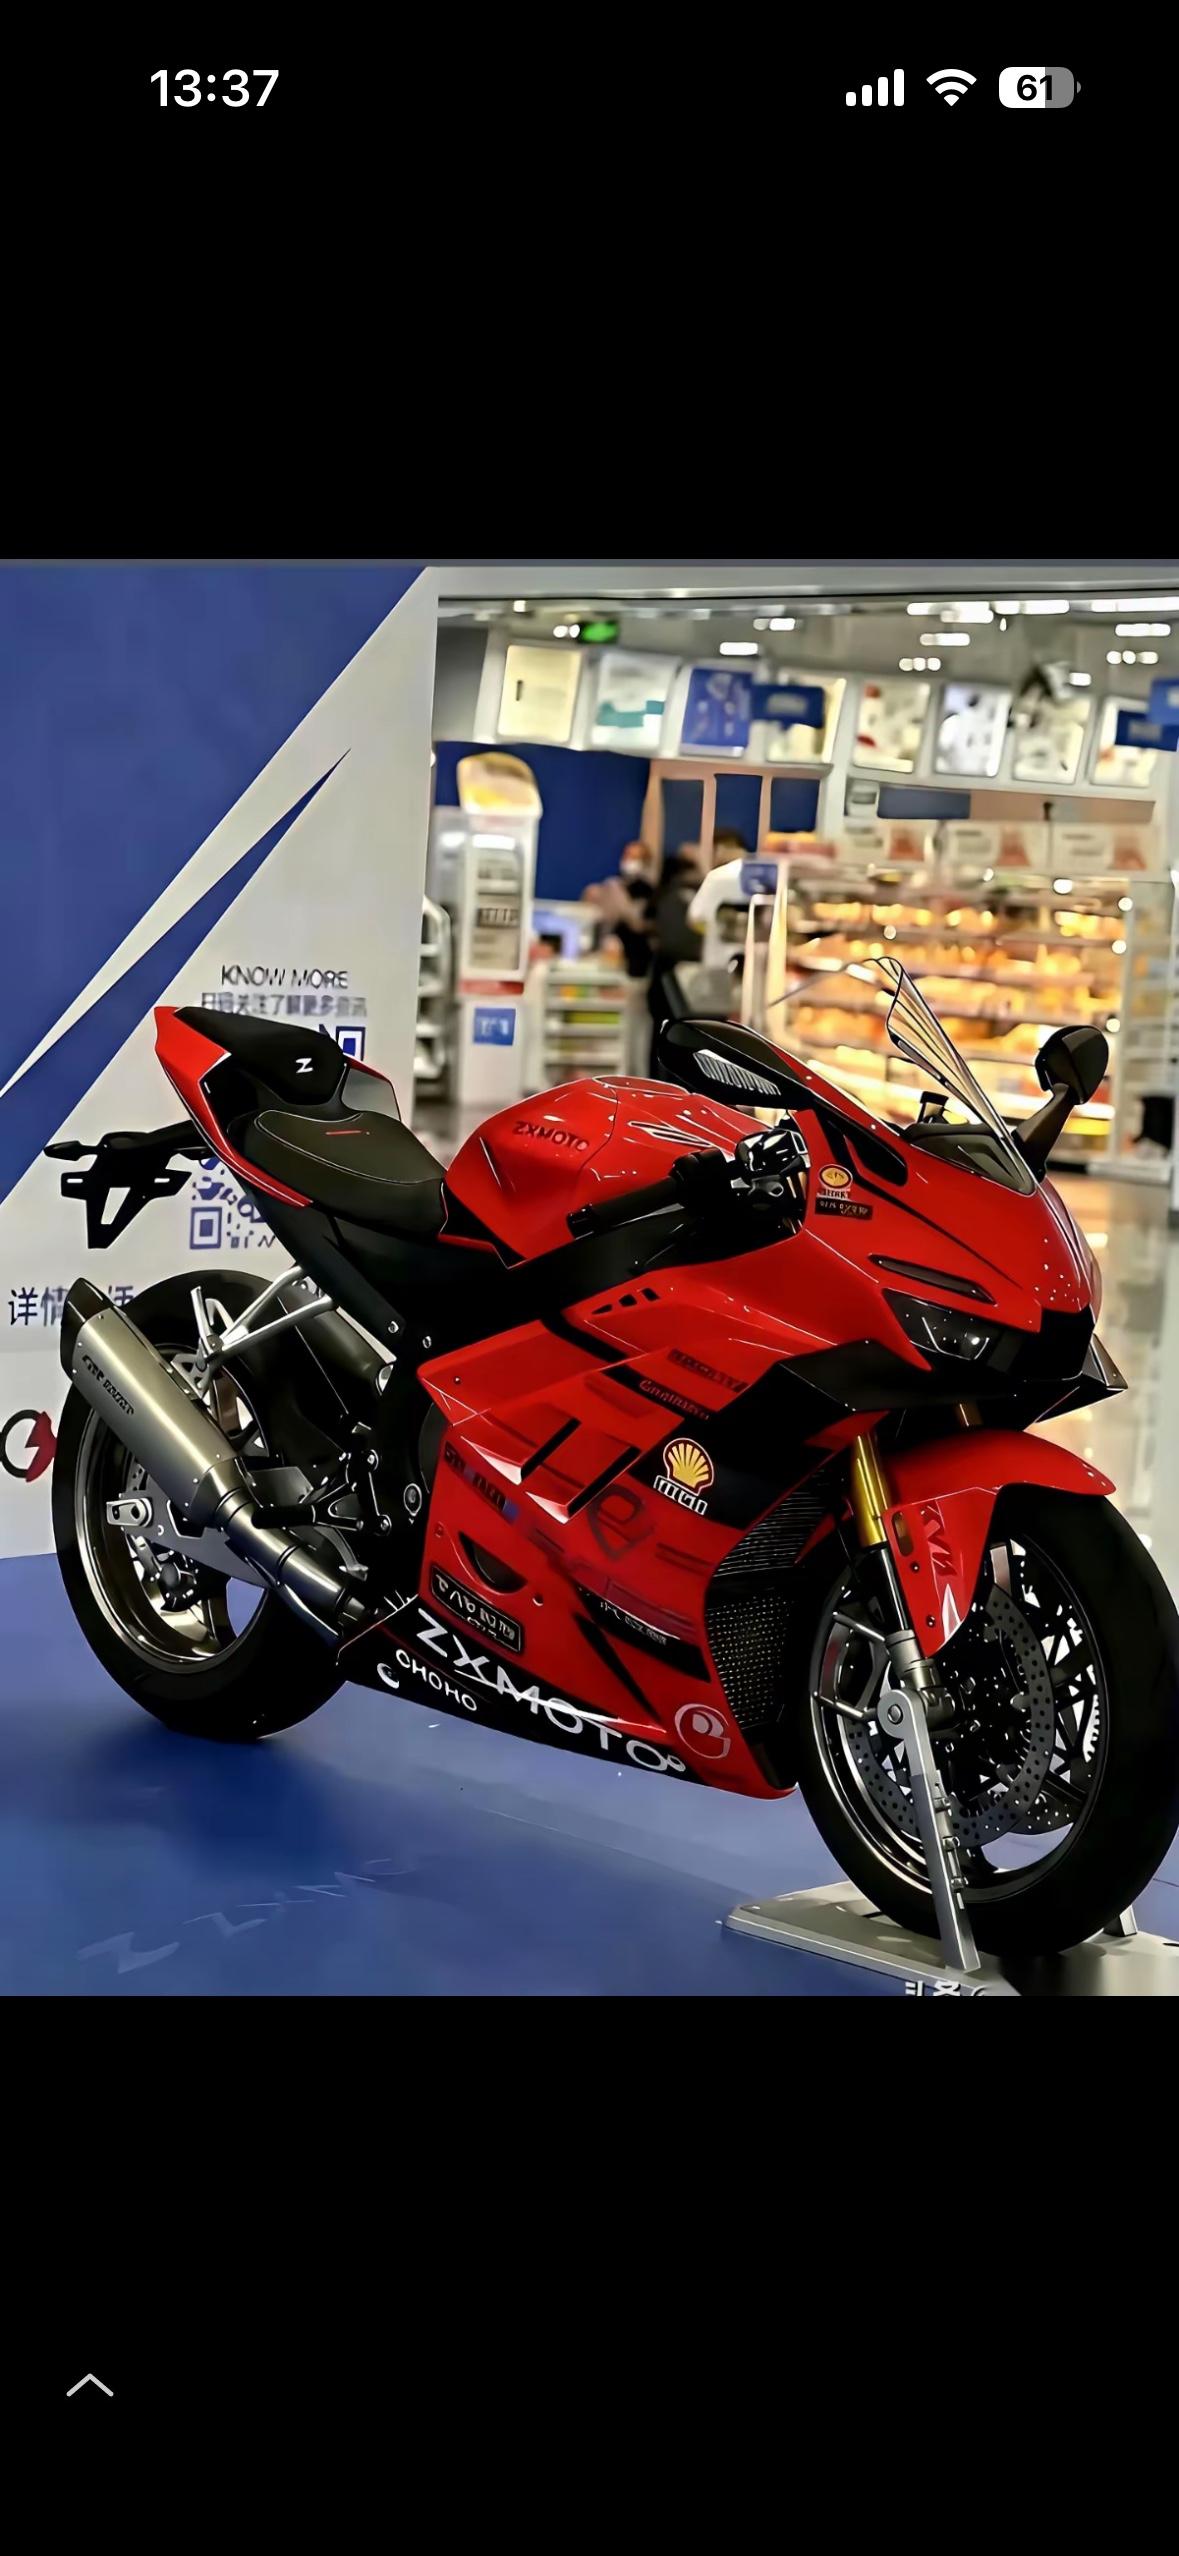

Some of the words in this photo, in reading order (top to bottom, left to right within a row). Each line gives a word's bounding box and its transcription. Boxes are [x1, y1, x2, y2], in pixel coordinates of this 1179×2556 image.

[221, 964, 286, 987] KNOW
[291, 968, 349, 990] MORE
[295, 1057, 313, 1074] Z
[512, 1120, 590, 1151] ZXMOTO
[416, 1608, 669, 1771] ZXMOTO
